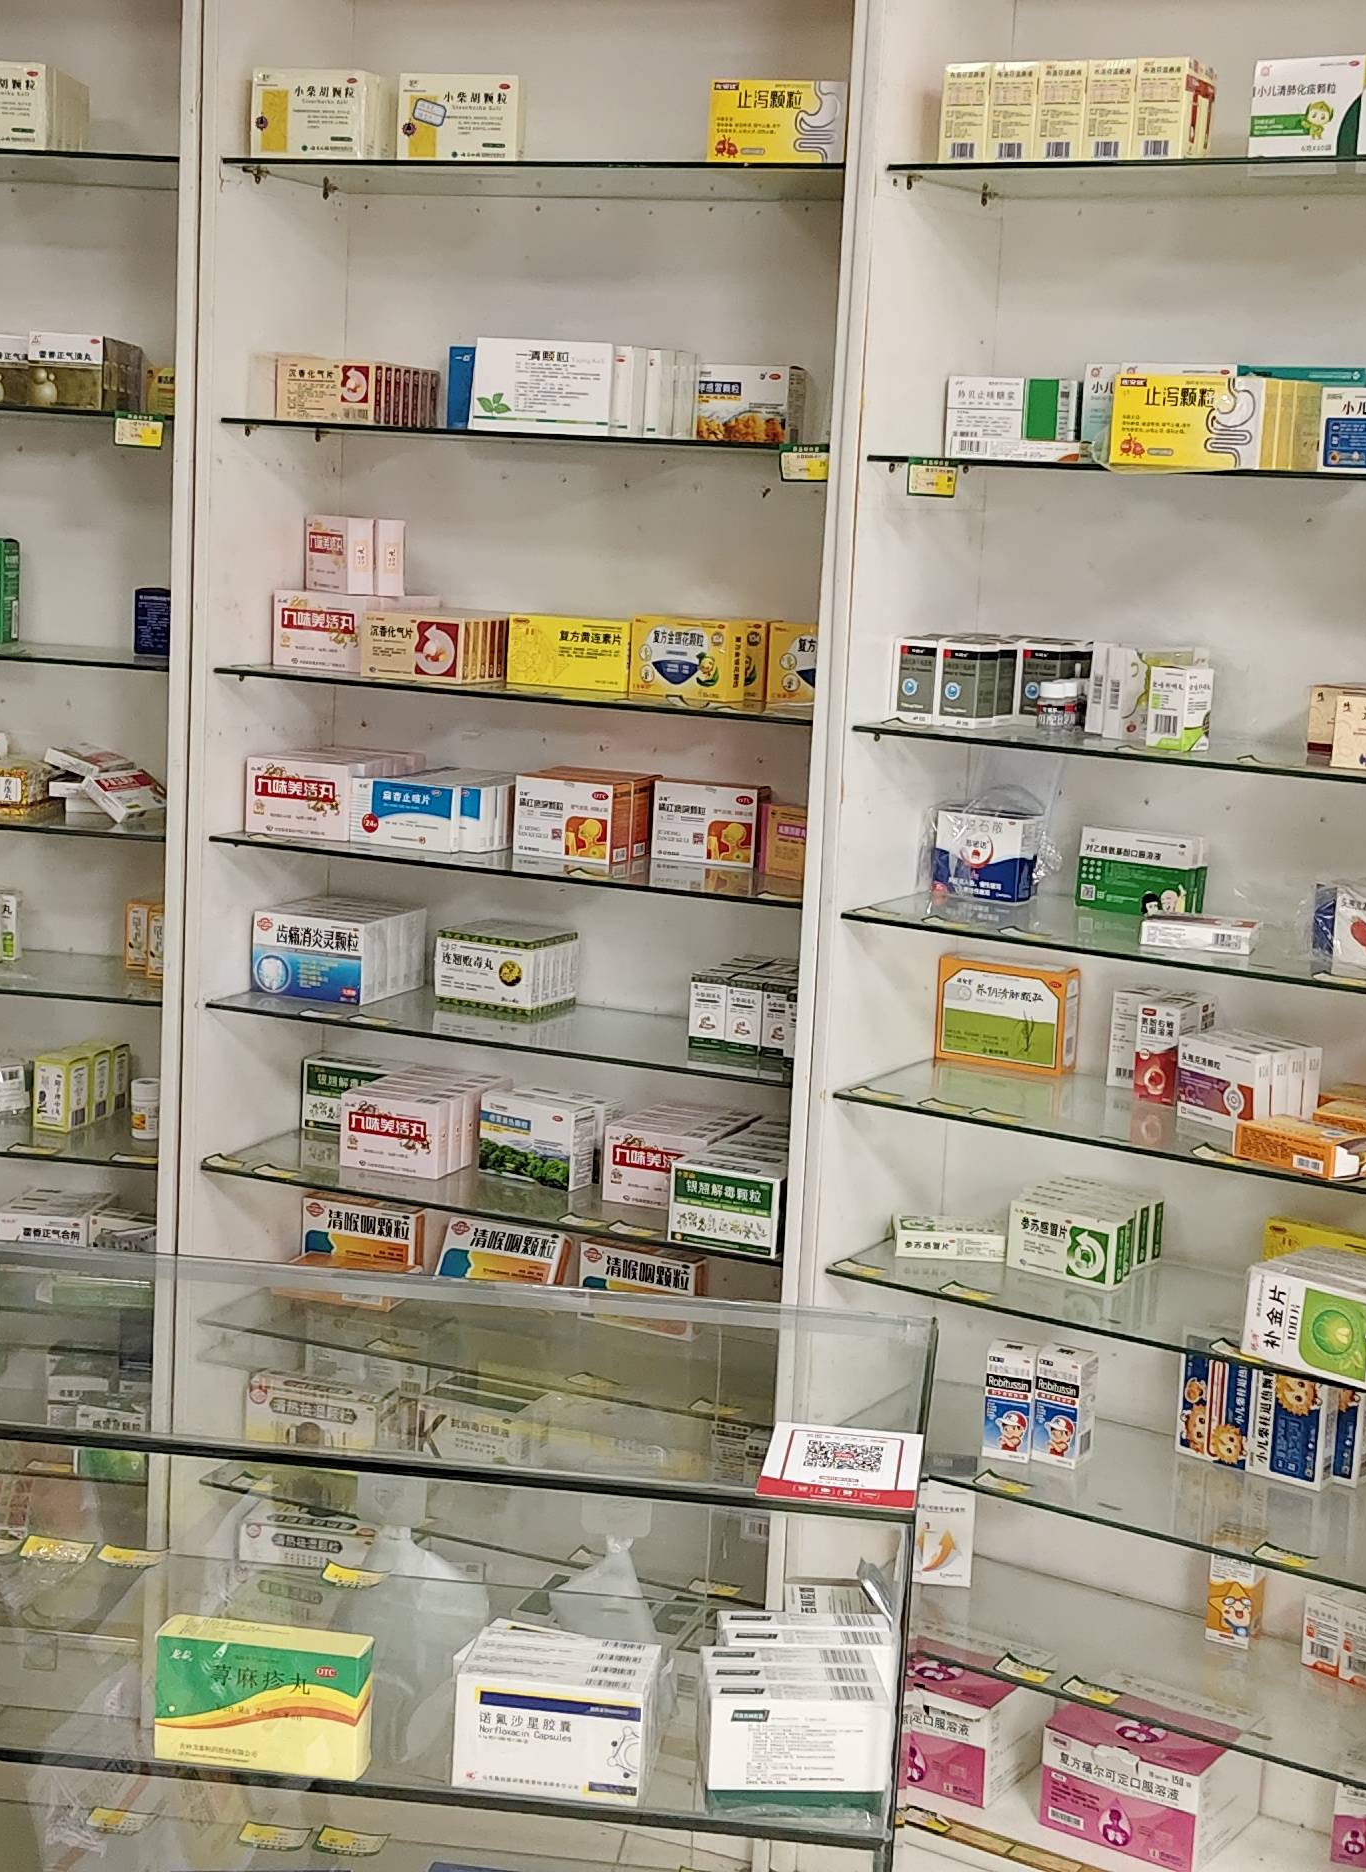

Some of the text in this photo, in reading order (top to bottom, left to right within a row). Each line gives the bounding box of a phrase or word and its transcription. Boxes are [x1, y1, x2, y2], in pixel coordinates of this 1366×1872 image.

[293, 85, 355, 98] 小柴胡颗粒
[443, 91, 507, 105] 小柴胡颗粒
[737, 90, 803, 109] 止泻颗粒
[1257, 83, 1336, 97] 小儿清肺化痰颗粒
[1144, 386, 1215, 408] 止泻颗粒
[283, 610, 354, 631] 九味羌活丸
[370, 625, 414, 639] 沉香化气片
[558, 630, 622, 645] 复方黄连素片
[652, 630, 704, 647] 复方金银花颗粒
[257, 778, 334, 800] 九味羌活丸
[1085, 843, 1162, 860] 对乙酰氨基酚口服溶液
[276, 925, 359, 952] 齿痛消炎灵颗粒
[441, 951, 494, 971] 连翘败毒丸
[351, 1115, 426, 1137] 九味羌活丸
[686, 1180, 762, 1204] 银翘解毒颗粒
[327, 1210, 410, 1241] 清喉咽颗粒
[1020, 1216, 1068, 1239] 参苏感冒片
[470, 1227, 557, 1259] 清喉咽颗粒
[605, 1255, 690, 1292] 清喉咽颗粒
[1263, 1285, 1286, 1349] 补金片
[988, 1375, 1029, 1391] Robitussin
[1038, 1378, 1076, 1396] Robitussin
[210, 1664, 311, 1696] 荨麻疹丸
[316, 1667, 335, 1677] OTC
[479, 1711, 572, 1733] 诺氟沙星胶囊
[479, 1725, 572, 1743] Norfloxacin Capsules
[1059, 1751, 1181, 1803] 复方福尔可定口服溶液
